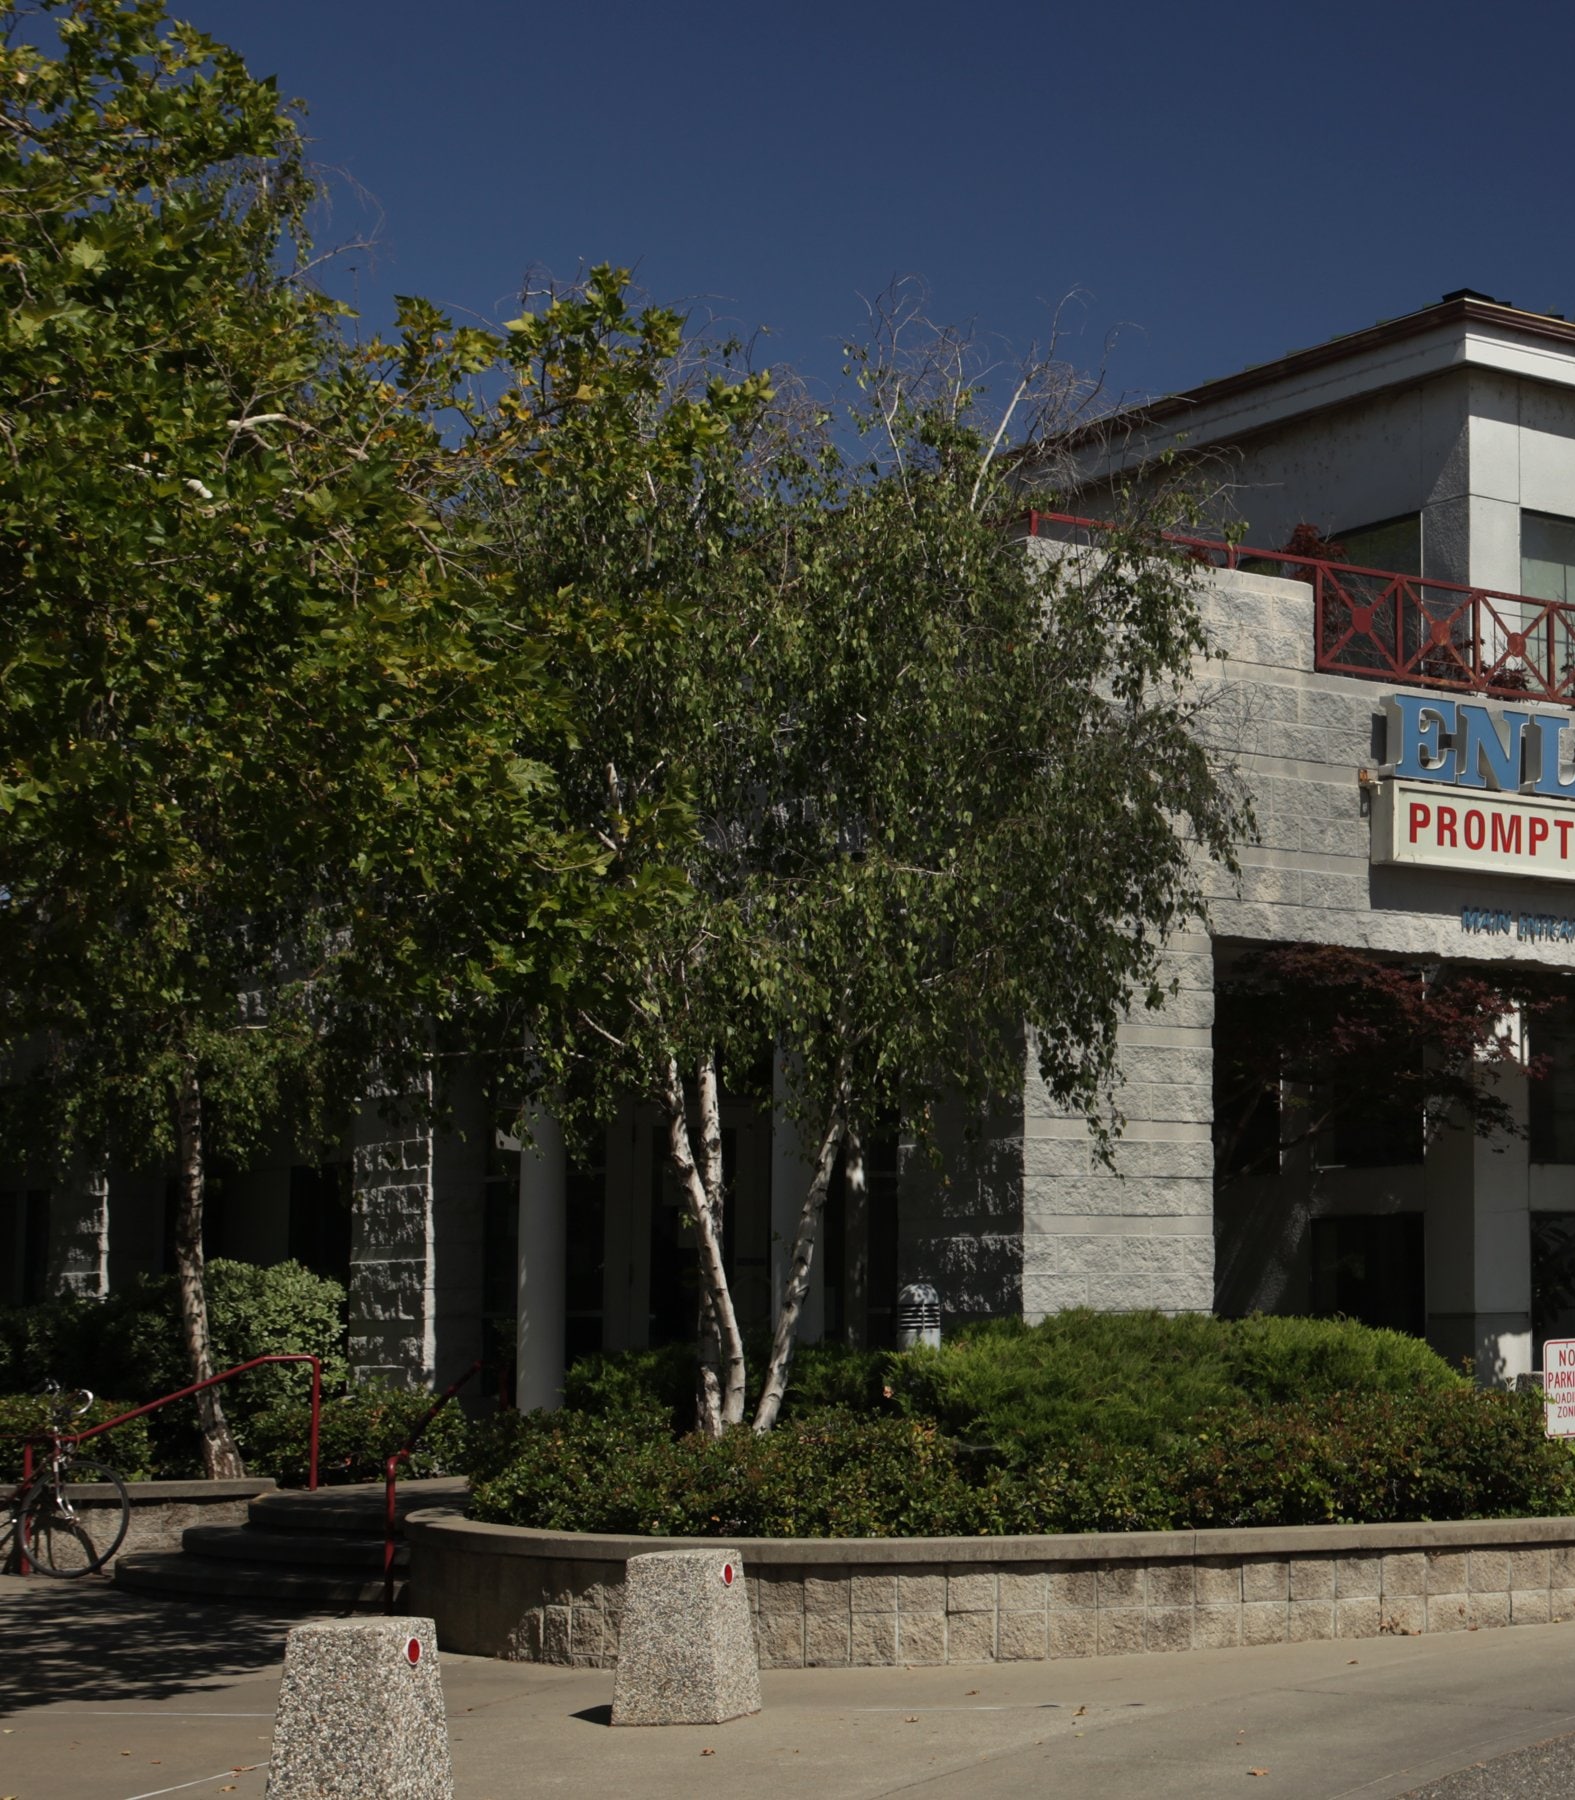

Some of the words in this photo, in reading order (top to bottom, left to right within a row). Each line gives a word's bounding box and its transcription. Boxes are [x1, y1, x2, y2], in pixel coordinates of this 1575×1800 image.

[1409, 802, 1574, 859] PROMPT
[1461, 910, 1512, 932] MAIN
[1558, 1349, 1575, 1367] NO
